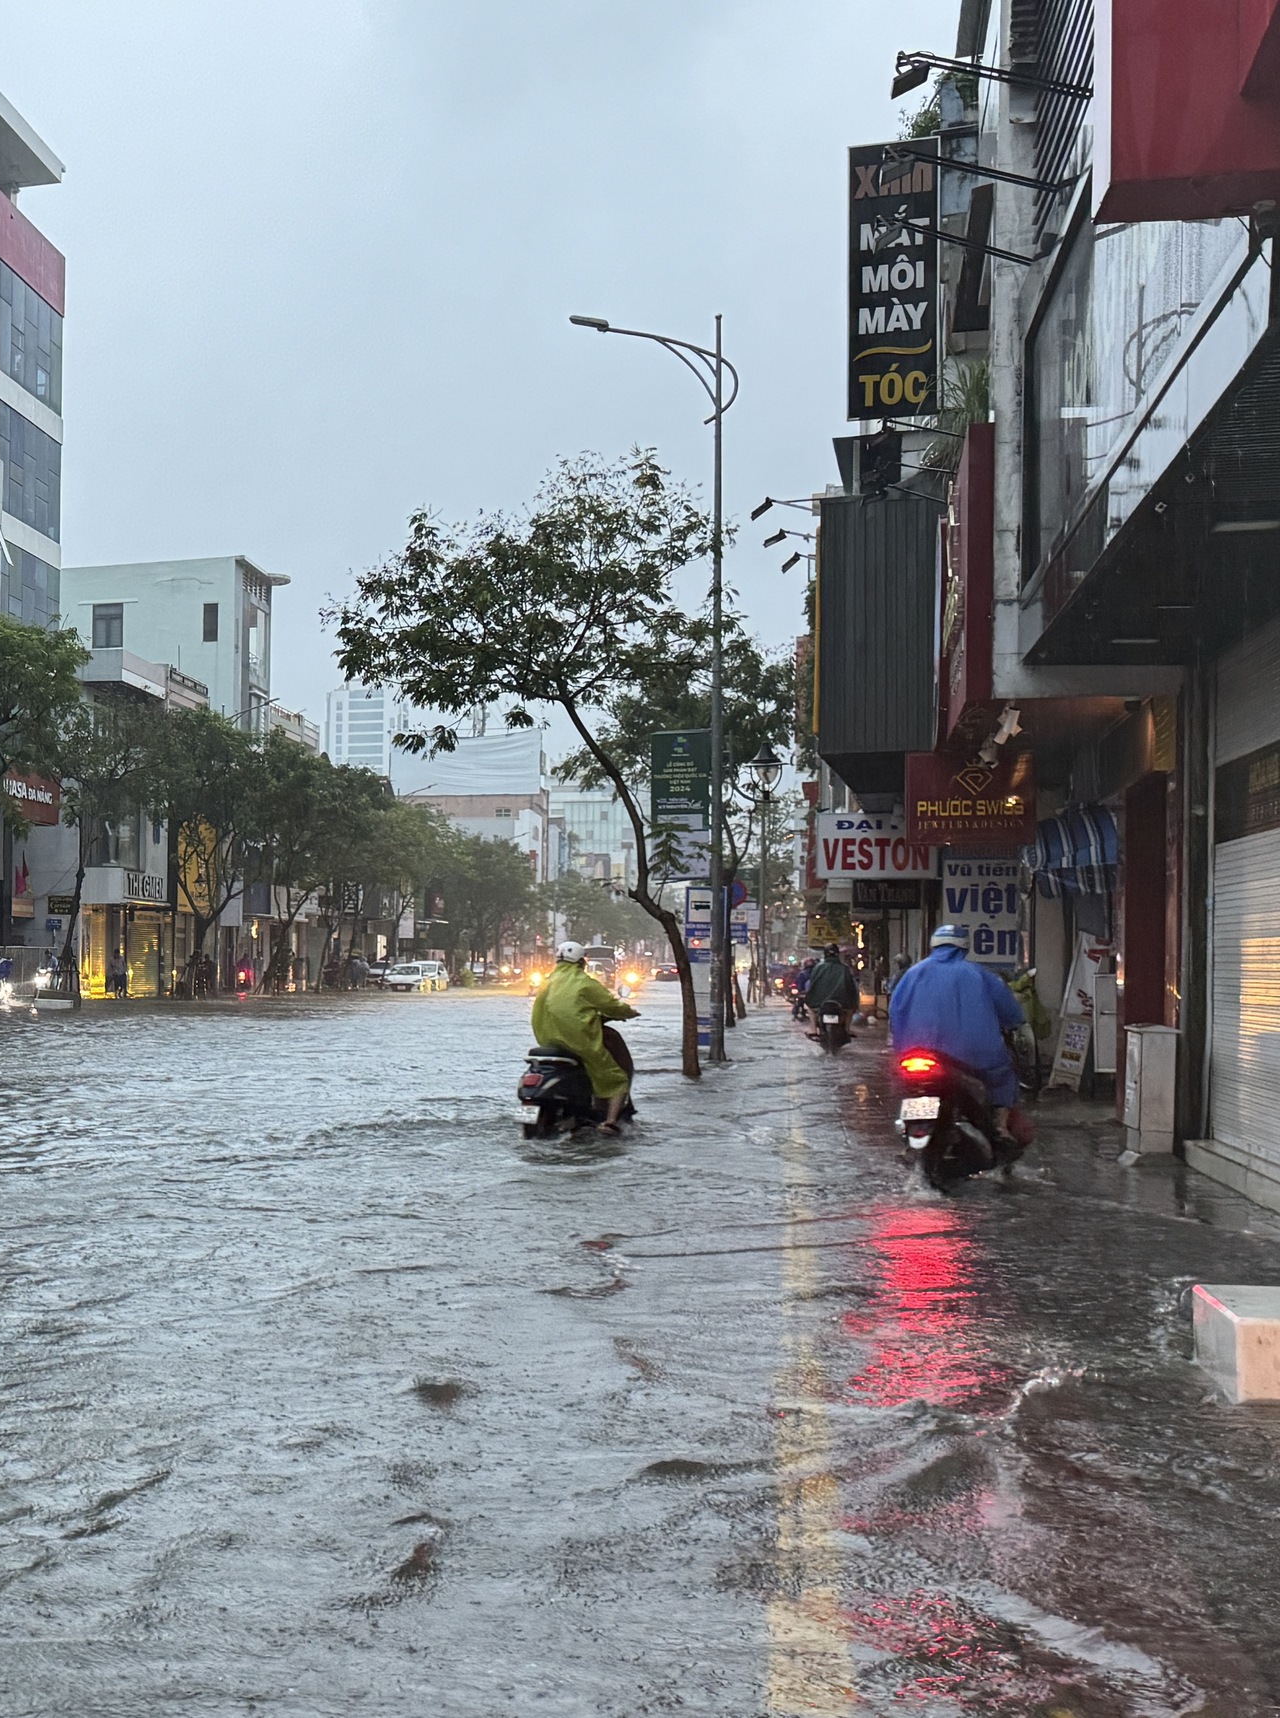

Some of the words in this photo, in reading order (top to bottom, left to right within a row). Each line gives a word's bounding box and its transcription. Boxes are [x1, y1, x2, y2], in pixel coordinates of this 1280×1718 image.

[862, 254, 925, 293] MÔI
[858, 297, 928, 335] MÀY
[859, 363, 928, 407] TÓC
[28, 785, 37, 802] ĐÀ
[37, 785, 53, 805] NẴNG
[917, 796, 972, 817] PHƯỚC
[976, 799, 1025, 816] SWISS
[835, 820, 883, 833] ĐẠI
[822, 837, 930, 871] VESTON
[127, 873, 142, 896] THE
[946, 881, 1017, 919] việt
